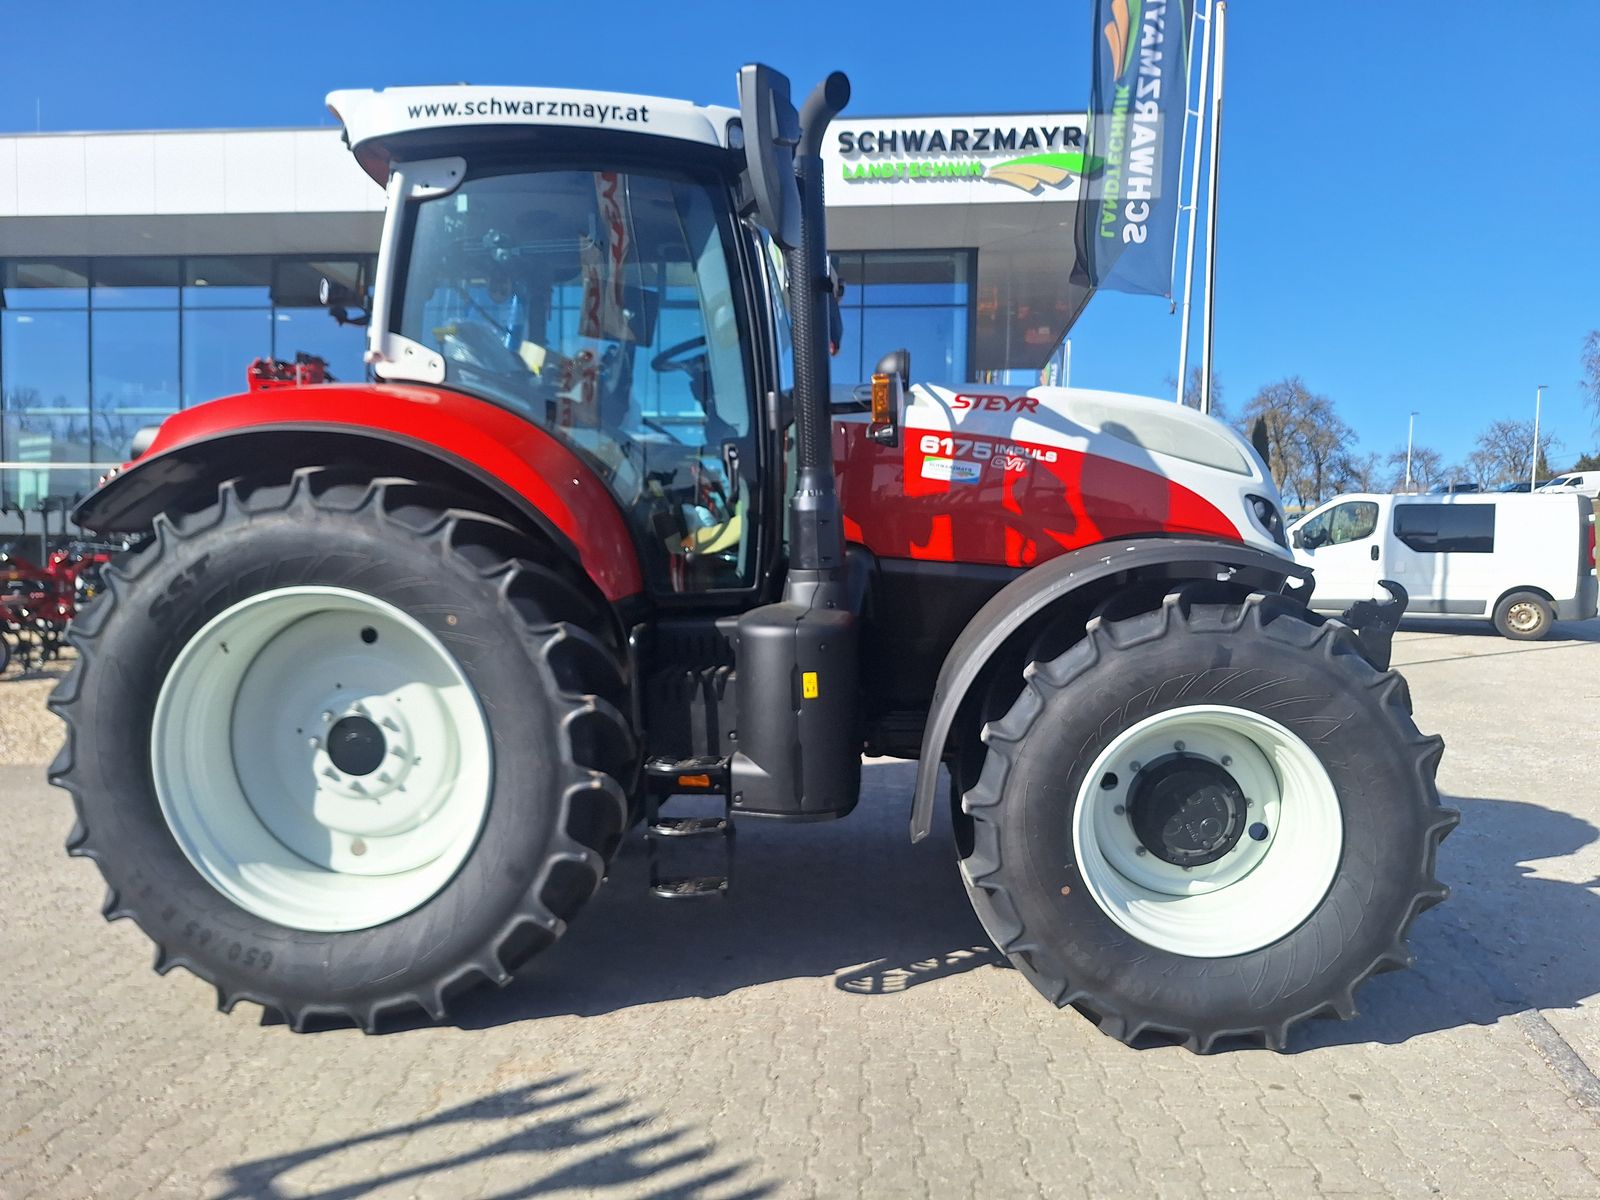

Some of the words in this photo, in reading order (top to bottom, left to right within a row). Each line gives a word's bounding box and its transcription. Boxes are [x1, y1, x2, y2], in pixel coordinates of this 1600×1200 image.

[408, 97, 649, 123] www.schwarzmayr.at
[838, 126, 1082, 153] SCHWARZMAYR
[842, 161, 983, 179] LANDTECHNIK
[951, 394, 1039, 414] STEYR
[920, 435, 992, 459] 6175
[995, 444, 1057, 462] IMPULS
[990, 455, 1030, 472] CVT
